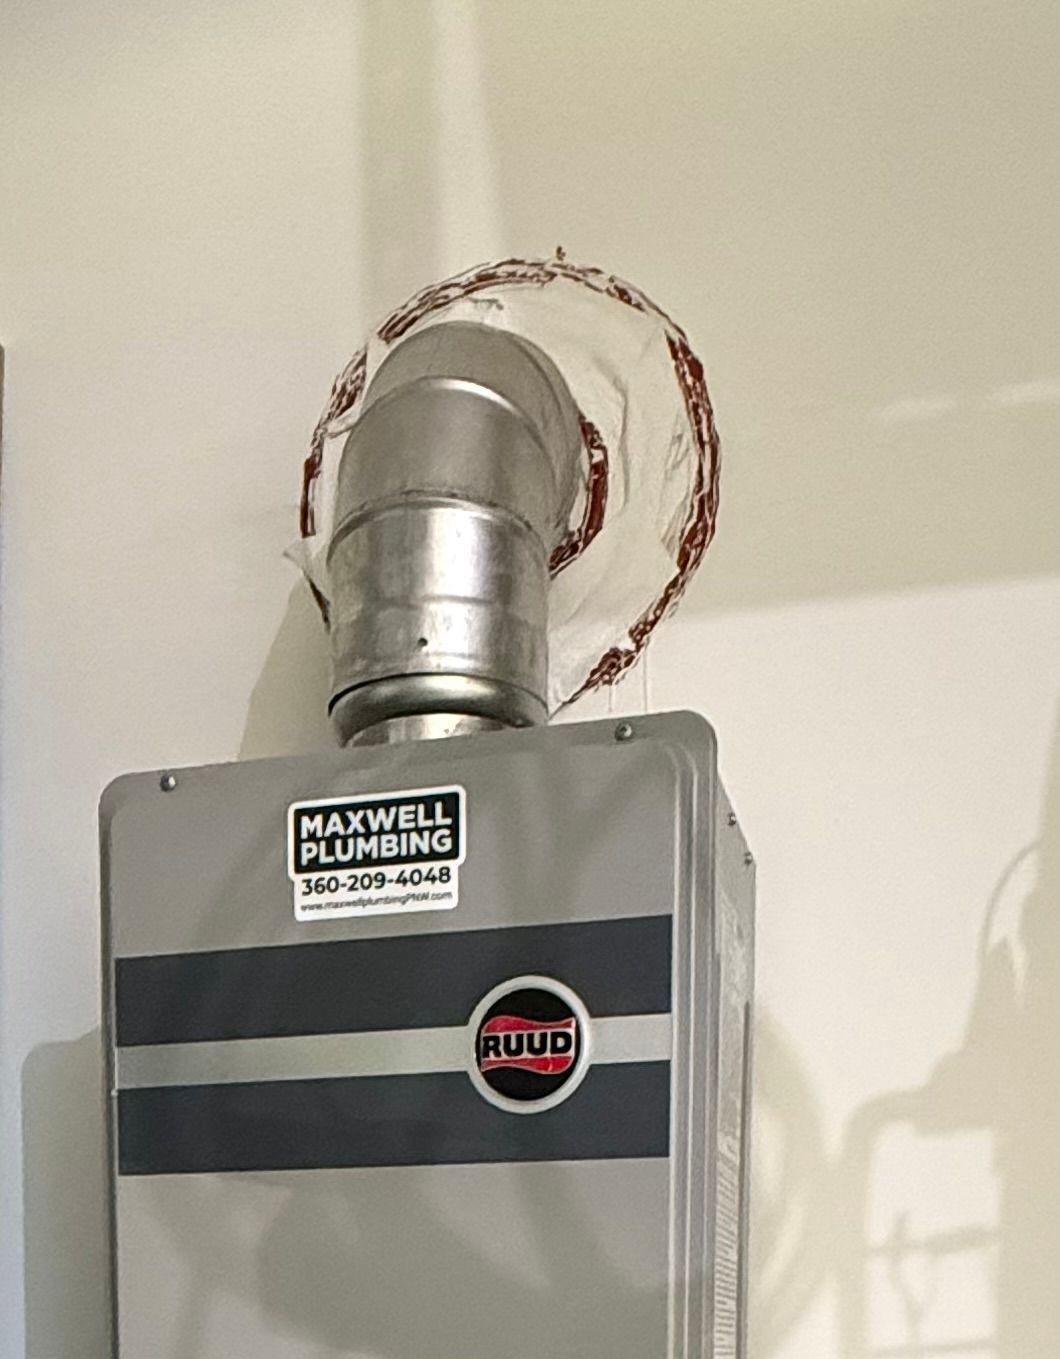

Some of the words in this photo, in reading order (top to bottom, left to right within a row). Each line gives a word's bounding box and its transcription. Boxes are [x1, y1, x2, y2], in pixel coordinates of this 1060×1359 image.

[301, 801, 452, 839] MAXWELL
[301, 829, 452, 866] PLUMBING
[302, 866, 451, 896] 360-209-4048
[482, 1031, 572, 1059] RUUD
